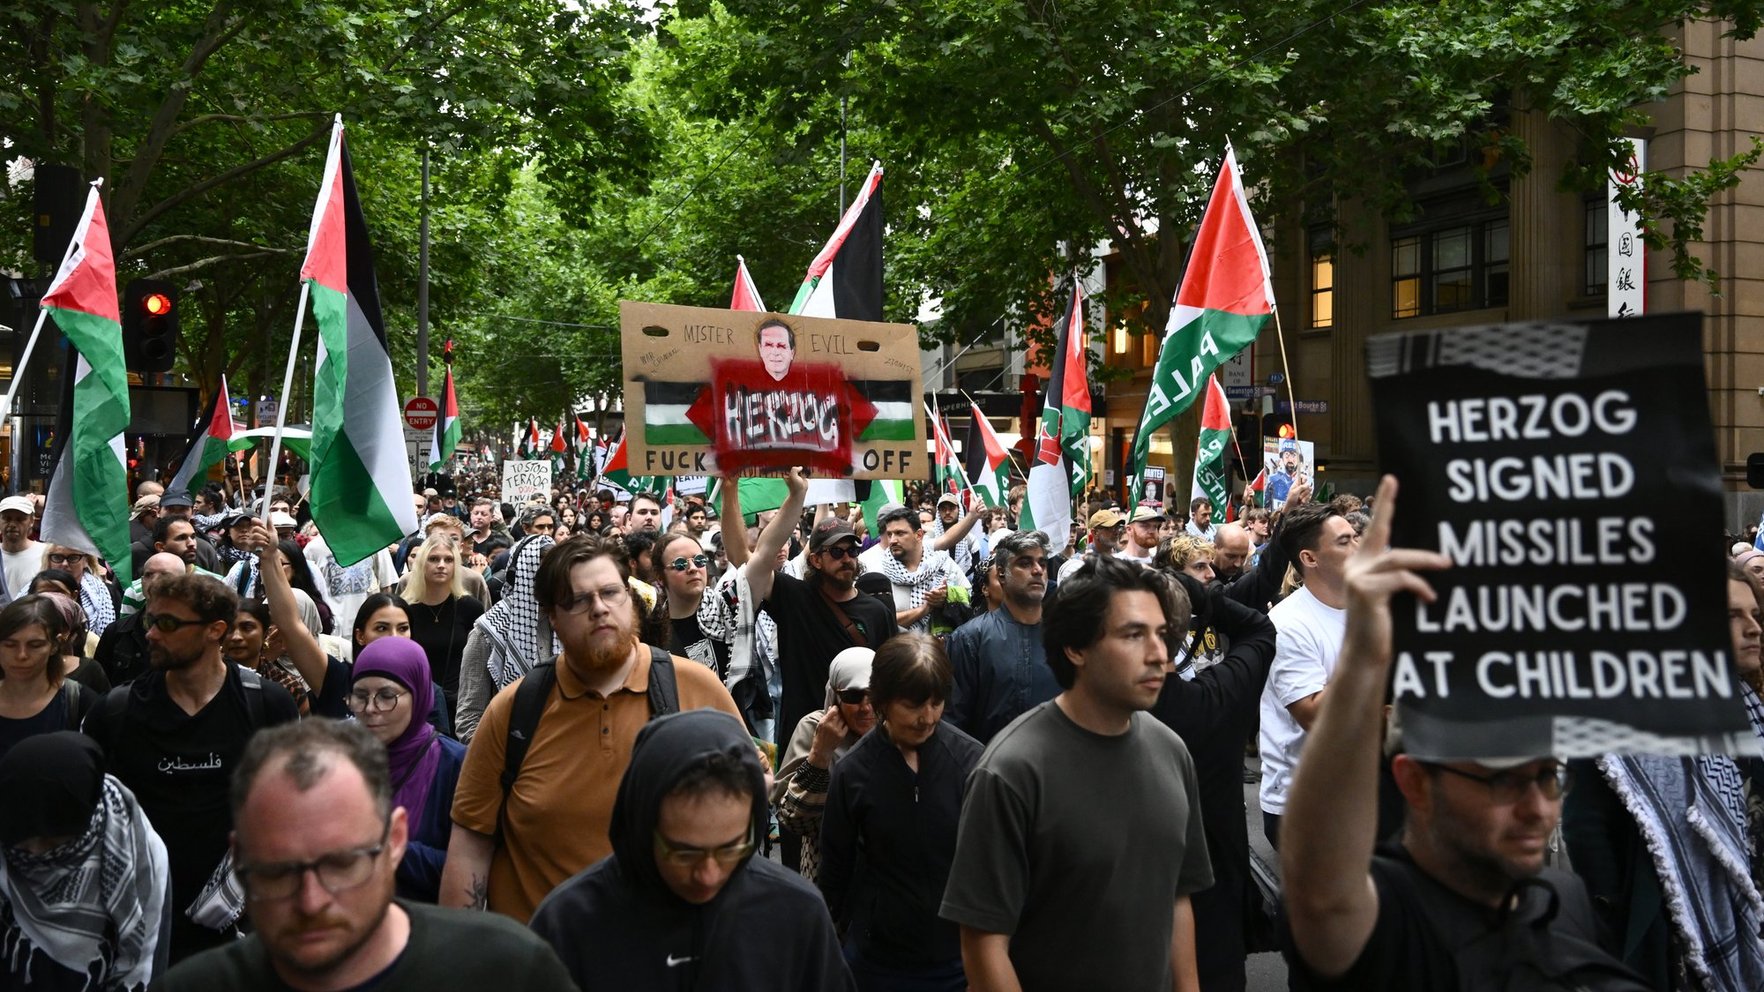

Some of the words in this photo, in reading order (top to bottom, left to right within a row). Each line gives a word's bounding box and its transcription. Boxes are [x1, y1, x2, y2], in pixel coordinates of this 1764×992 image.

[683, 325, 735, 345] MISTER
[810, 333, 854, 355] EVIL
[884, 358, 915, 376] ZIONIST
[1227, 387, 1254, 395] Swanston
[416, 402, 428, 410] NO
[1427, 390, 1638, 444] HERZOG
[409, 417, 434, 425] ENTRY
[724, 389, 839, 450] HERZOG
[511, 463, 524, 473] TO
[525, 461, 549, 475] STOP
[646, 450, 706, 472] FUCK
[862, 449, 912, 474] OFF
[506, 473, 549, 490] TERROR
[1446, 452, 1635, 503] SIGNED
[1437, 517, 1655, 567] MISSILES
[1416, 584, 1687, 633] LAUNCHED
[1393, 652, 1455, 699] AT
[1475, 650, 1733, 699] CHILDREN
[158, 752, 222, 775] فلسطين
